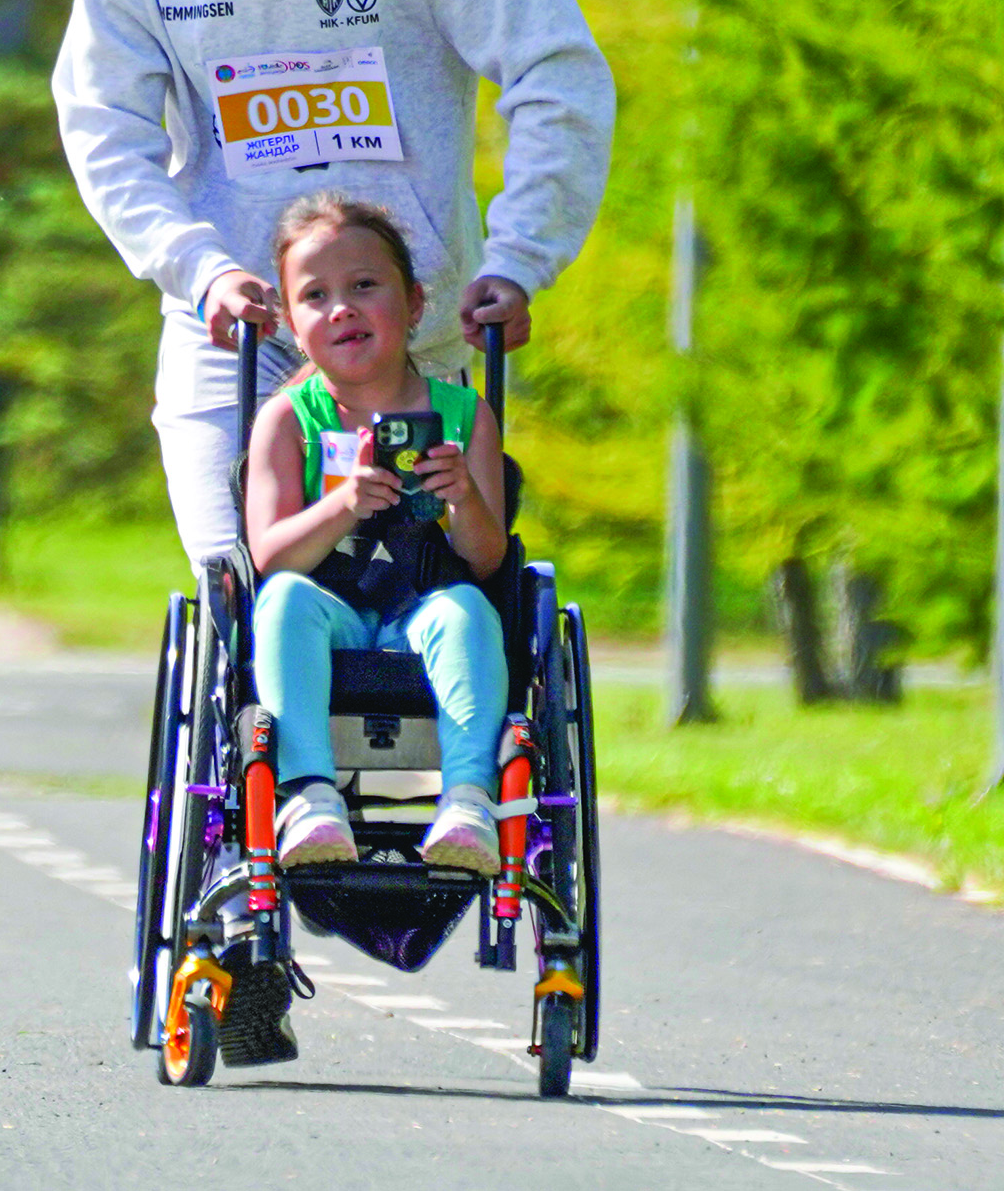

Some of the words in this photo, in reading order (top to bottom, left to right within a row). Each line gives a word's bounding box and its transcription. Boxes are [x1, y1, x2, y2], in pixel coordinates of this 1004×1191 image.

[319, 18, 339, 29] HIK
[346, 13, 380, 27] KFUM
[247, 86, 370, 134] 0030
[246, 134, 295, 151] ЖІГЕРЛІ
[332, 133, 342, 150] 1
[245, 144, 300, 161] ЖАНДАР
